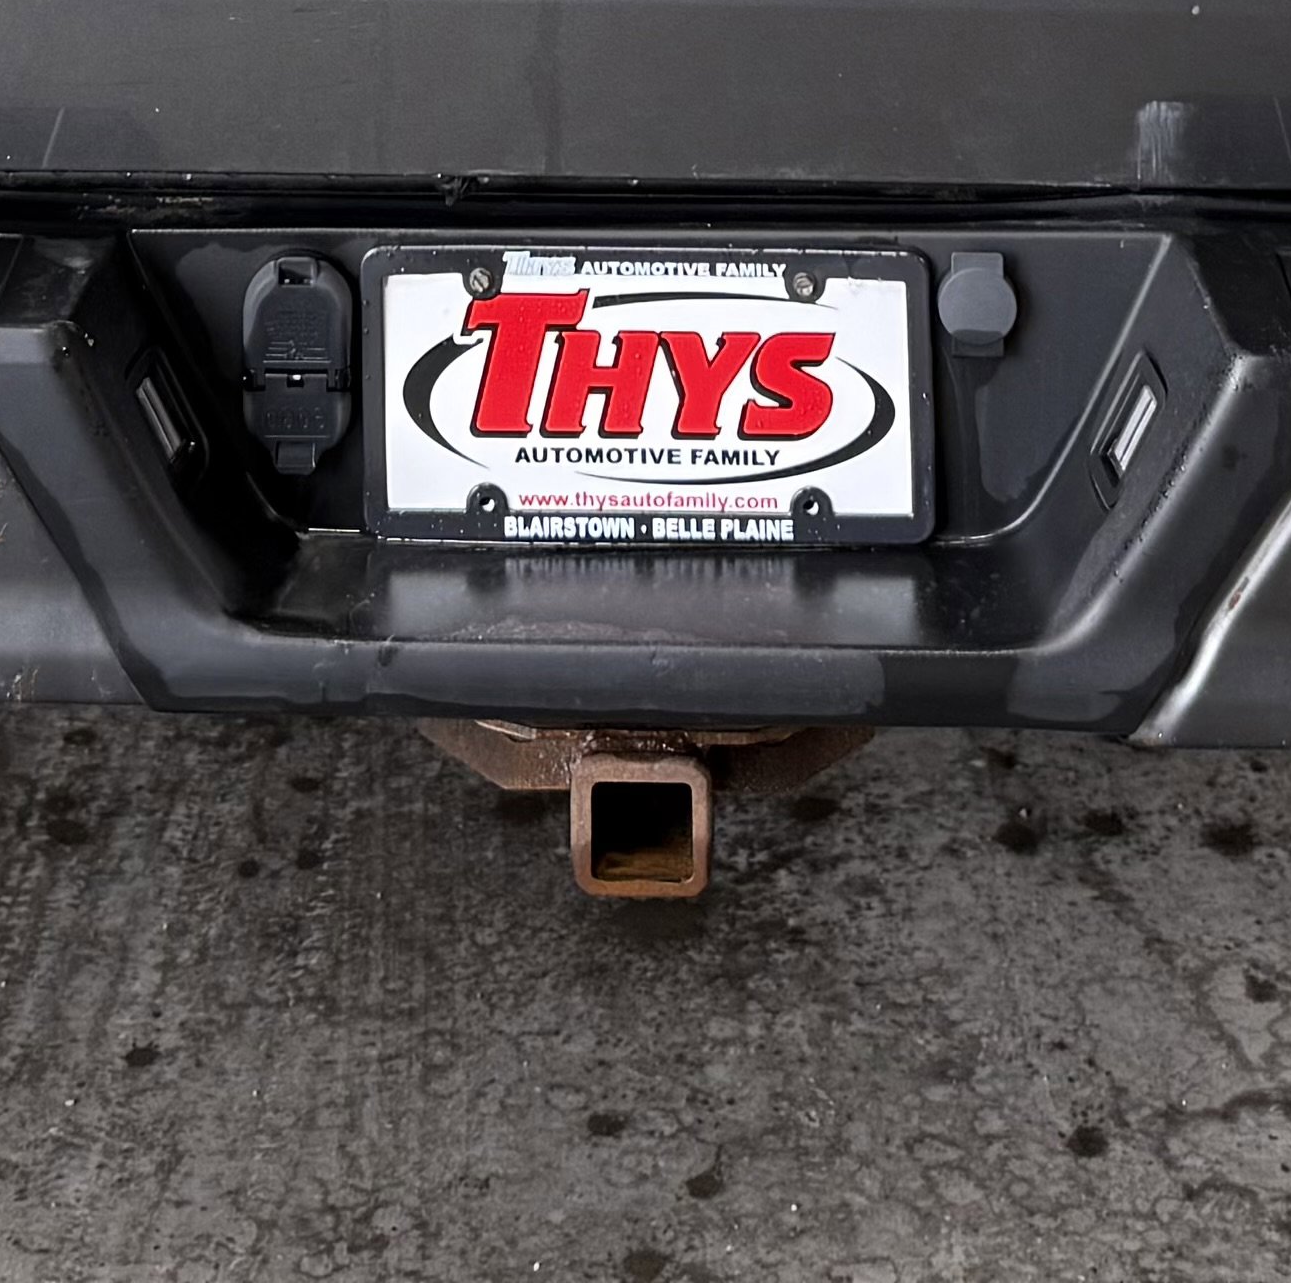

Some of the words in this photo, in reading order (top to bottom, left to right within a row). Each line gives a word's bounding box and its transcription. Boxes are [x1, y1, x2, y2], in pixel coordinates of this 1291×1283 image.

[581, 260, 709, 276] AUTOMOTIVE
[715, 262, 787, 278] FAMILY
[466, 288, 837, 440] THYS
[514, 446, 684, 465] AUTOMOTIVE
[690, 448, 781, 467] FAMILY
[518, 490, 779, 512] www.thysautofamily.com
[503, 515, 636, 539] BLAIRSTOWN
[651, 517, 716, 540] BELLE
[720, 518, 795, 541] PLAINE
